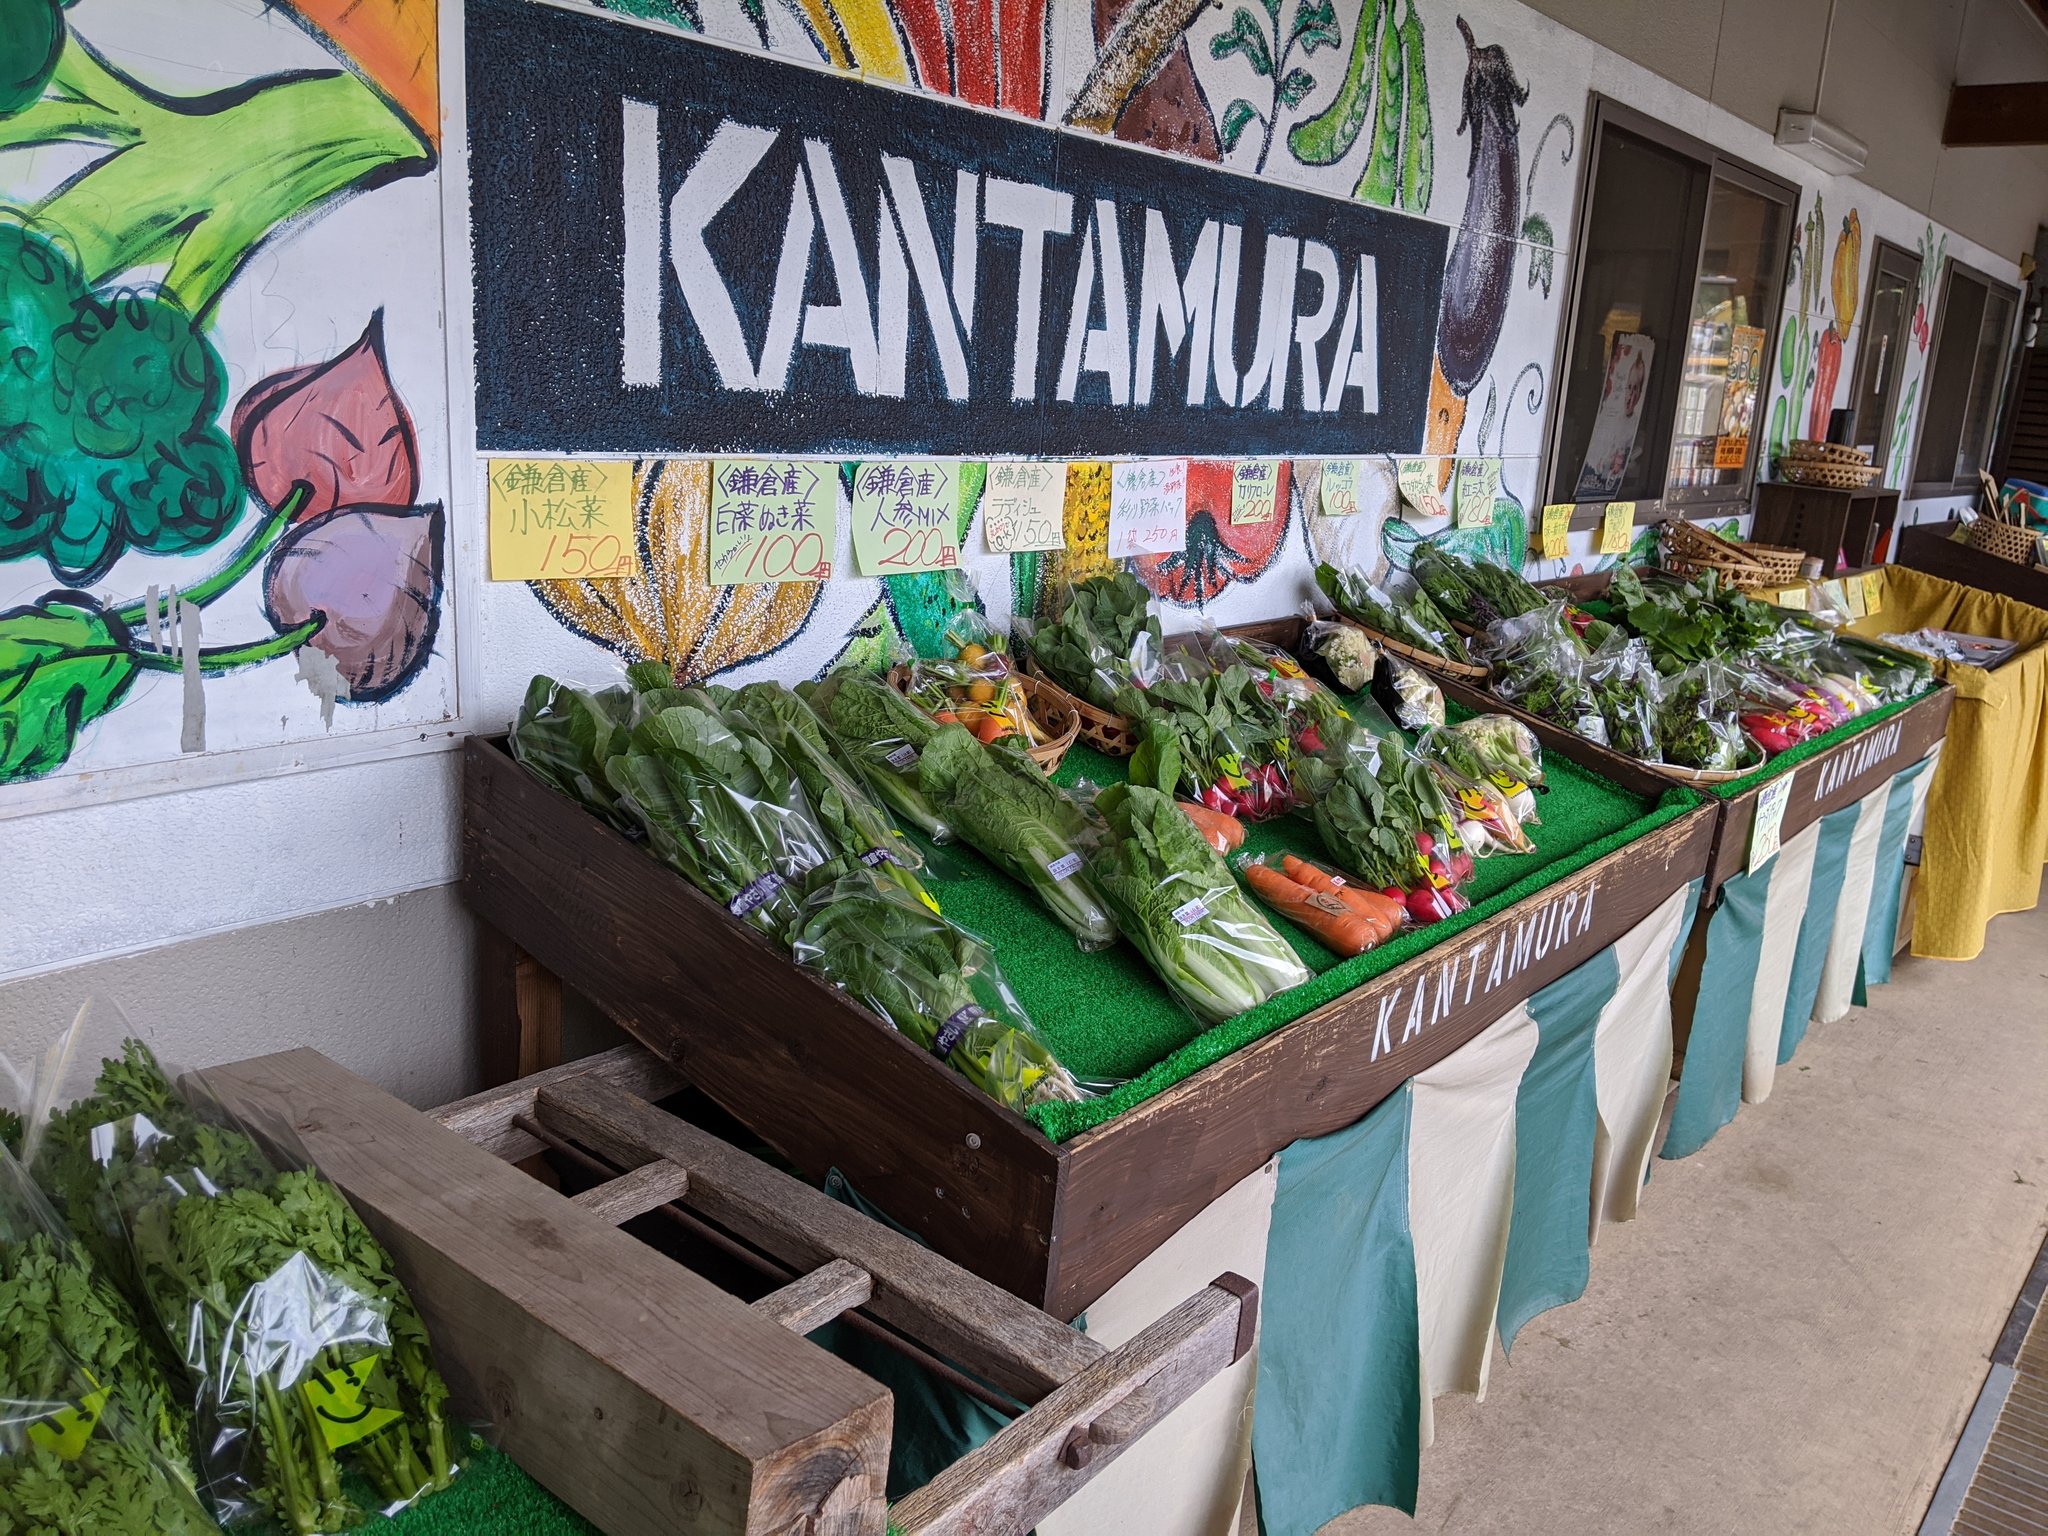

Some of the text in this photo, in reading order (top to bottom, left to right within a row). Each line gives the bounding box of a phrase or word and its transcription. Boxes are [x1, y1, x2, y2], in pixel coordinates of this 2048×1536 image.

[621, 98, 1379, 414] KANTAMURA
[510, 496, 609, 535] 小松菜
[716, 499, 816, 535] 白菜ぬき菜
[540, 533, 633, 576] 150円
[745, 533, 831, 580] 100円
[879, 528, 957, 567] 200円
[1814, 719, 1903, 802] KANTAMURA
[1370, 880, 1596, 1063] KANTAMURA
